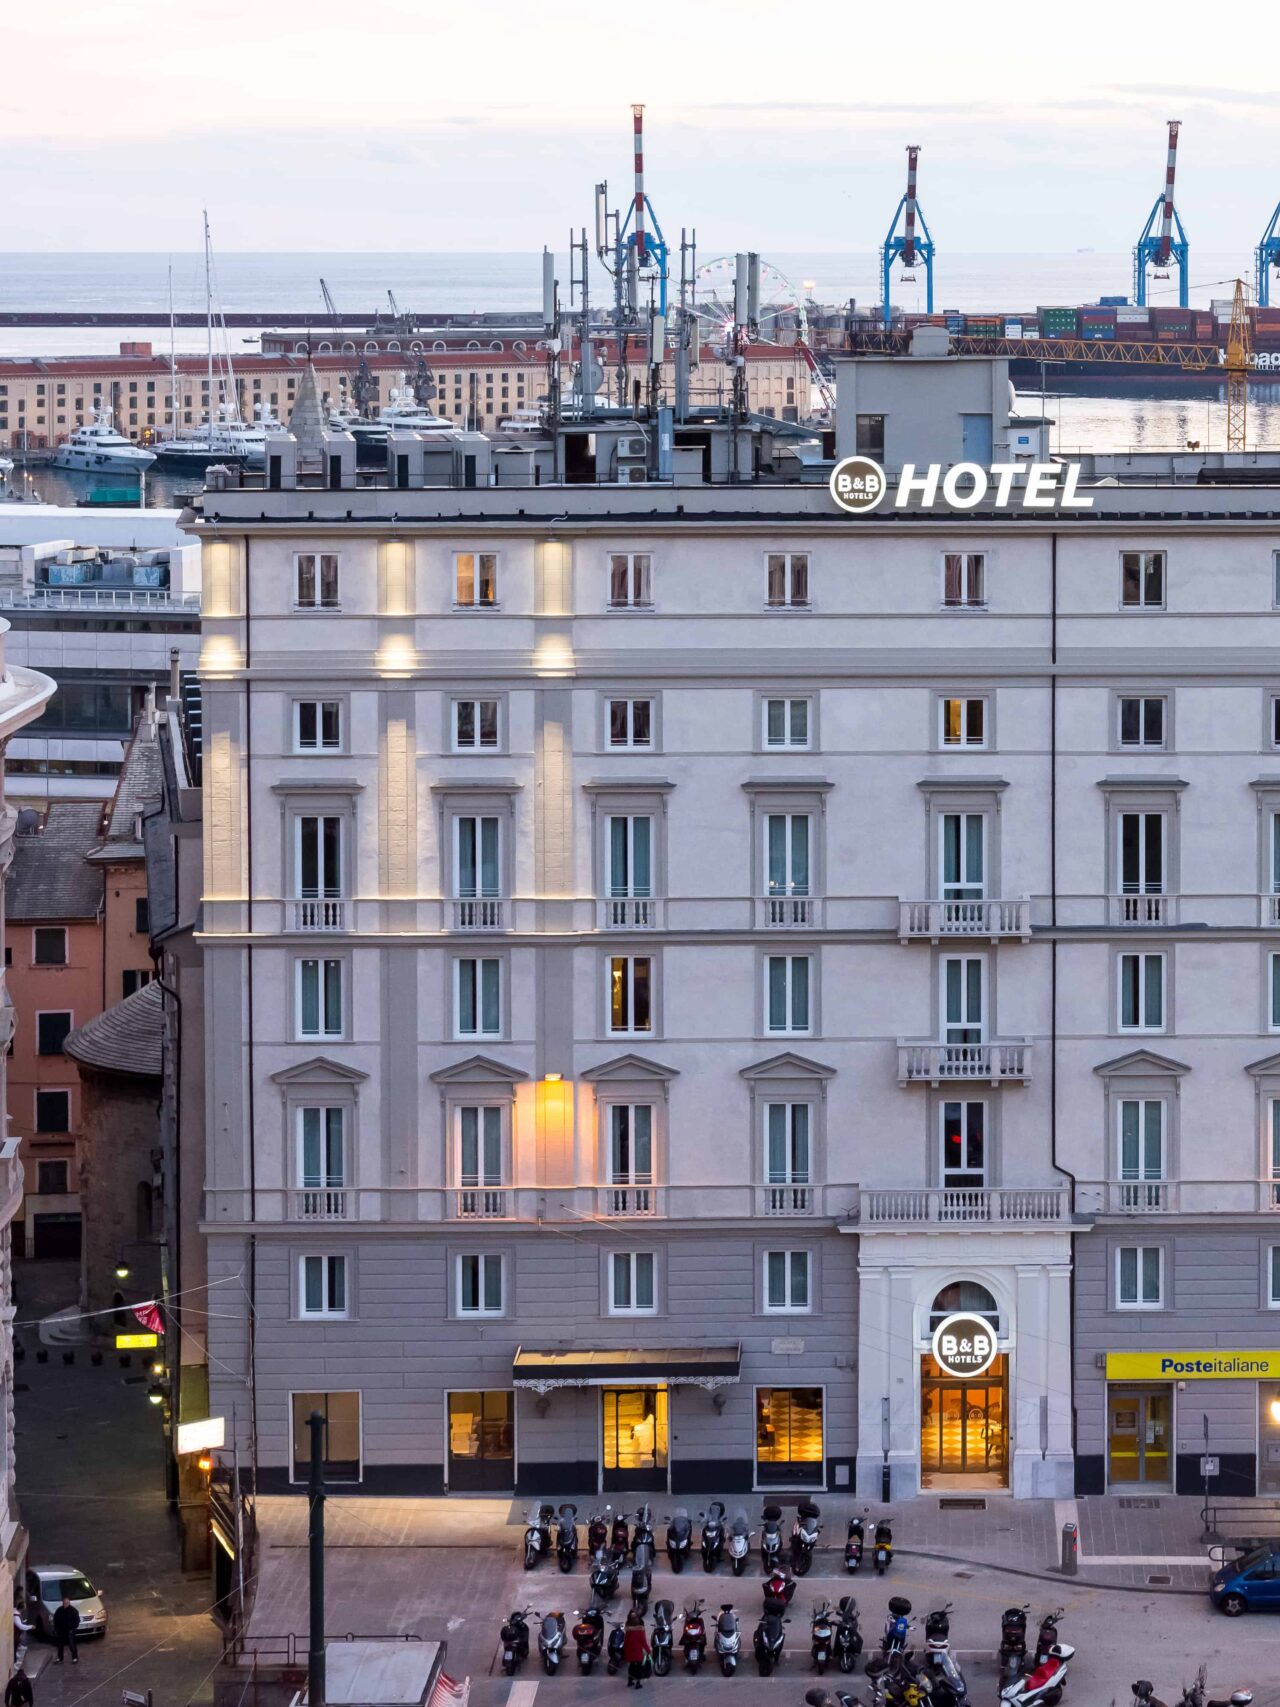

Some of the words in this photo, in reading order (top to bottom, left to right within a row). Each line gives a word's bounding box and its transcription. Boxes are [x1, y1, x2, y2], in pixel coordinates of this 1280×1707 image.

[837, 474, 879, 493] B&B
[895, 462, 1094, 508] HOTEL
[843, 492, 873, 500] HOTELS
[942, 1335, 990, 1356] B&B
[948, 1355, 983, 1363] HOTELS
[1161, 1358, 1269, 1373] Posteitaliane
